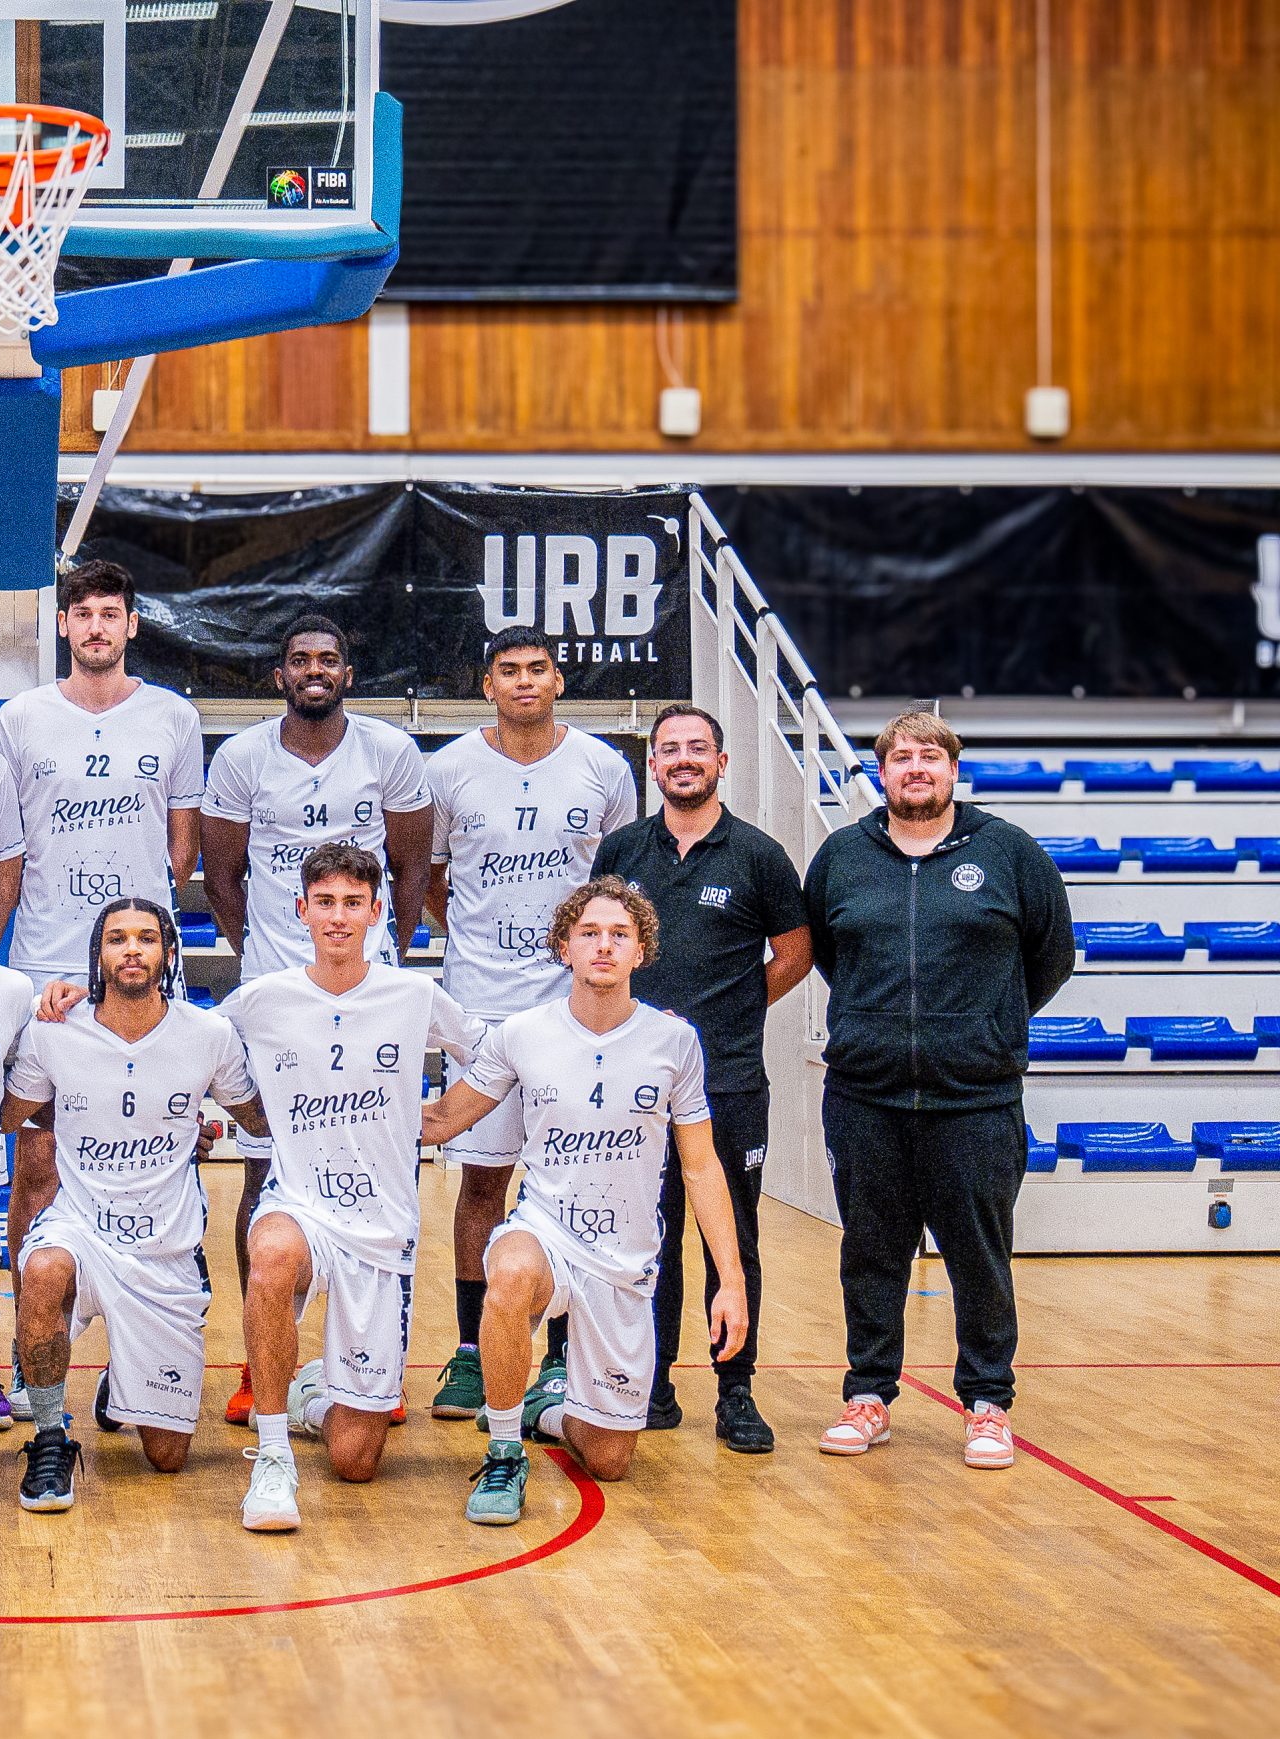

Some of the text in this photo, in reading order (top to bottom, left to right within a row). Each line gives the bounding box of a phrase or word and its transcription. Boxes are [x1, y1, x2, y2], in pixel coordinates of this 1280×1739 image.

[317, 172, 347, 188] FIBA
[476, 535, 663, 636] URB
[86, 754, 110, 777] 22
[51, 793, 145, 825] Rennes
[303, 803, 328, 828] 34
[515, 807, 538, 831] 77
[51, 814, 141, 834] BASKETBALL
[271, 836, 363, 864] Renes
[479, 846, 574, 877] Rennes
[70, 867, 125, 905] itga
[482, 869, 569, 888] BASKETBALL
[700, 886, 727, 904] URB
[331, 1044, 344, 1071] 2
[122, 1091, 135, 1117] 6
[289, 1086, 391, 1121] Rennes
[589, 1082, 604, 1109] 4
[293, 1111, 386, 1134] BASKETBALL
[77, 1132, 179, 1161] Rennes
[544, 1126, 647, 1155] Rennes
[80, 1154, 174, 1172] BASKETBALL
[545, 1149, 641, 1167] BASKETBALL
[745, 1148, 763, 1166] URB
[315, 1167, 377, 1207] itga
[97, 1204, 156, 1244] itga
[559, 1199, 618, 1243] itga
